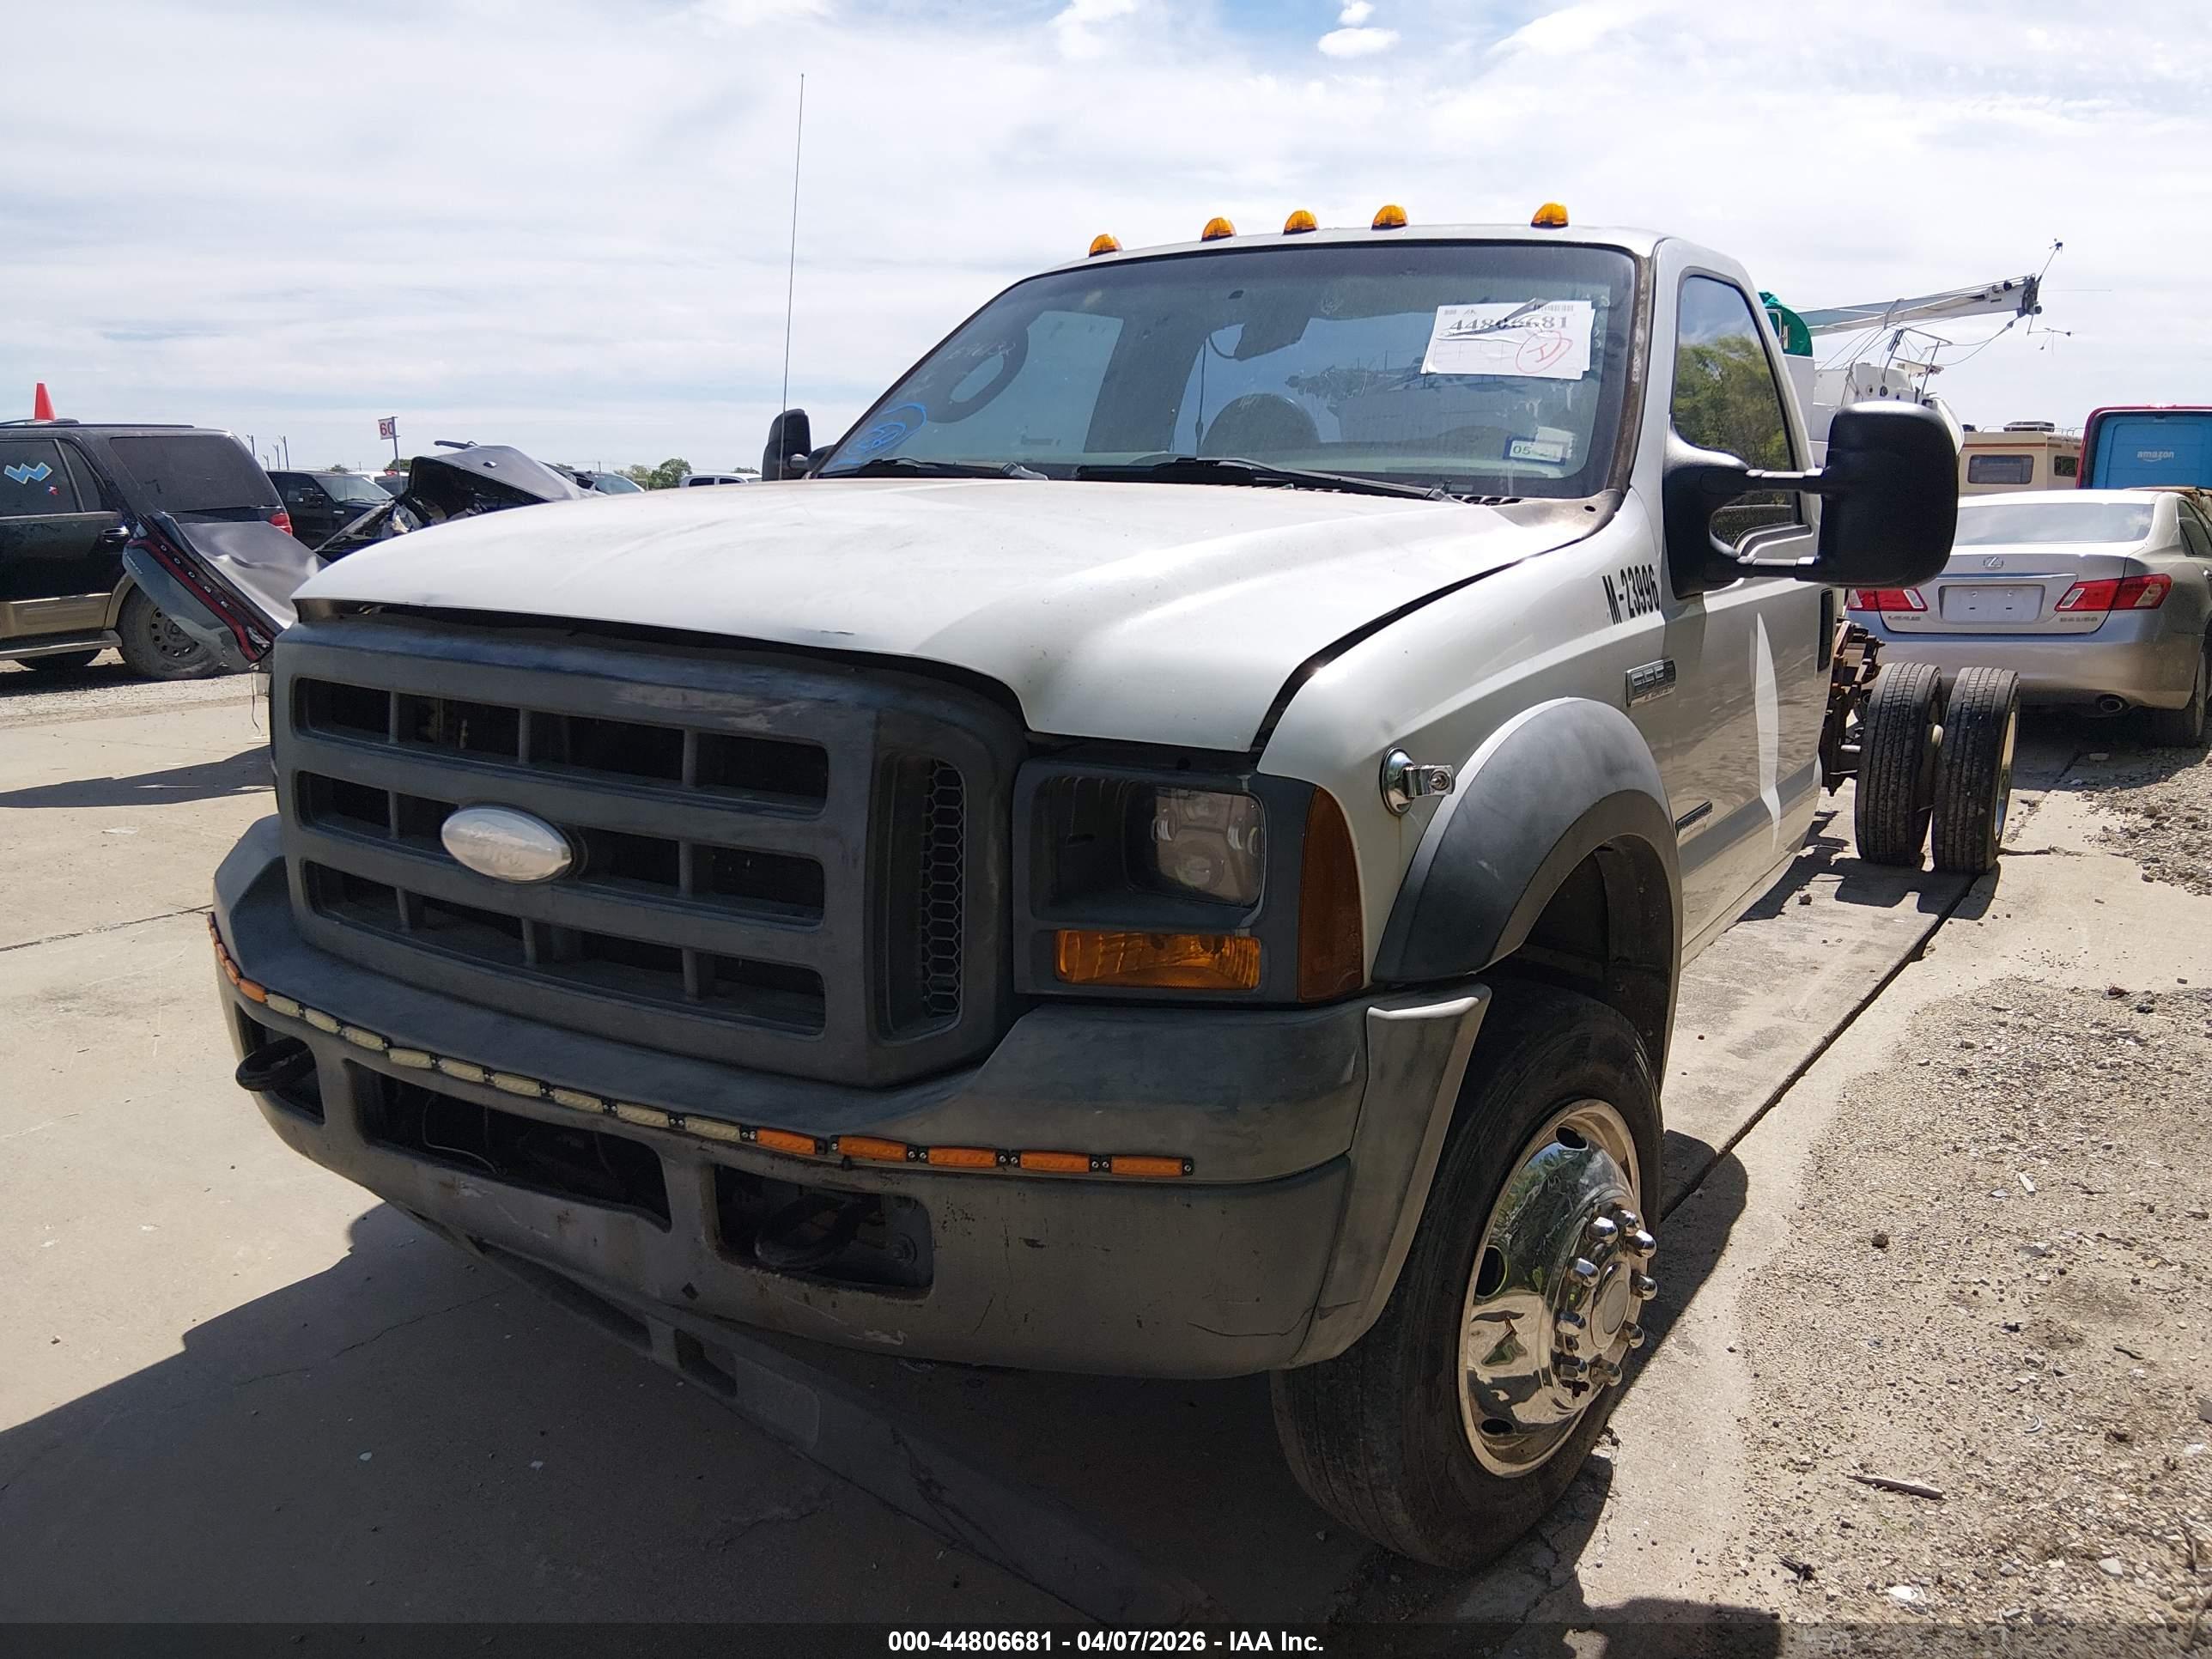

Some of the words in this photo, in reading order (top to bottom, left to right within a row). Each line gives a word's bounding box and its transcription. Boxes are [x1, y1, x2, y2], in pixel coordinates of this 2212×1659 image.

[2136, 451, 2175, 460] amazon
[160, 544, 229, 609] DODGE
[1601, 563, 1661, 626] M-23996
